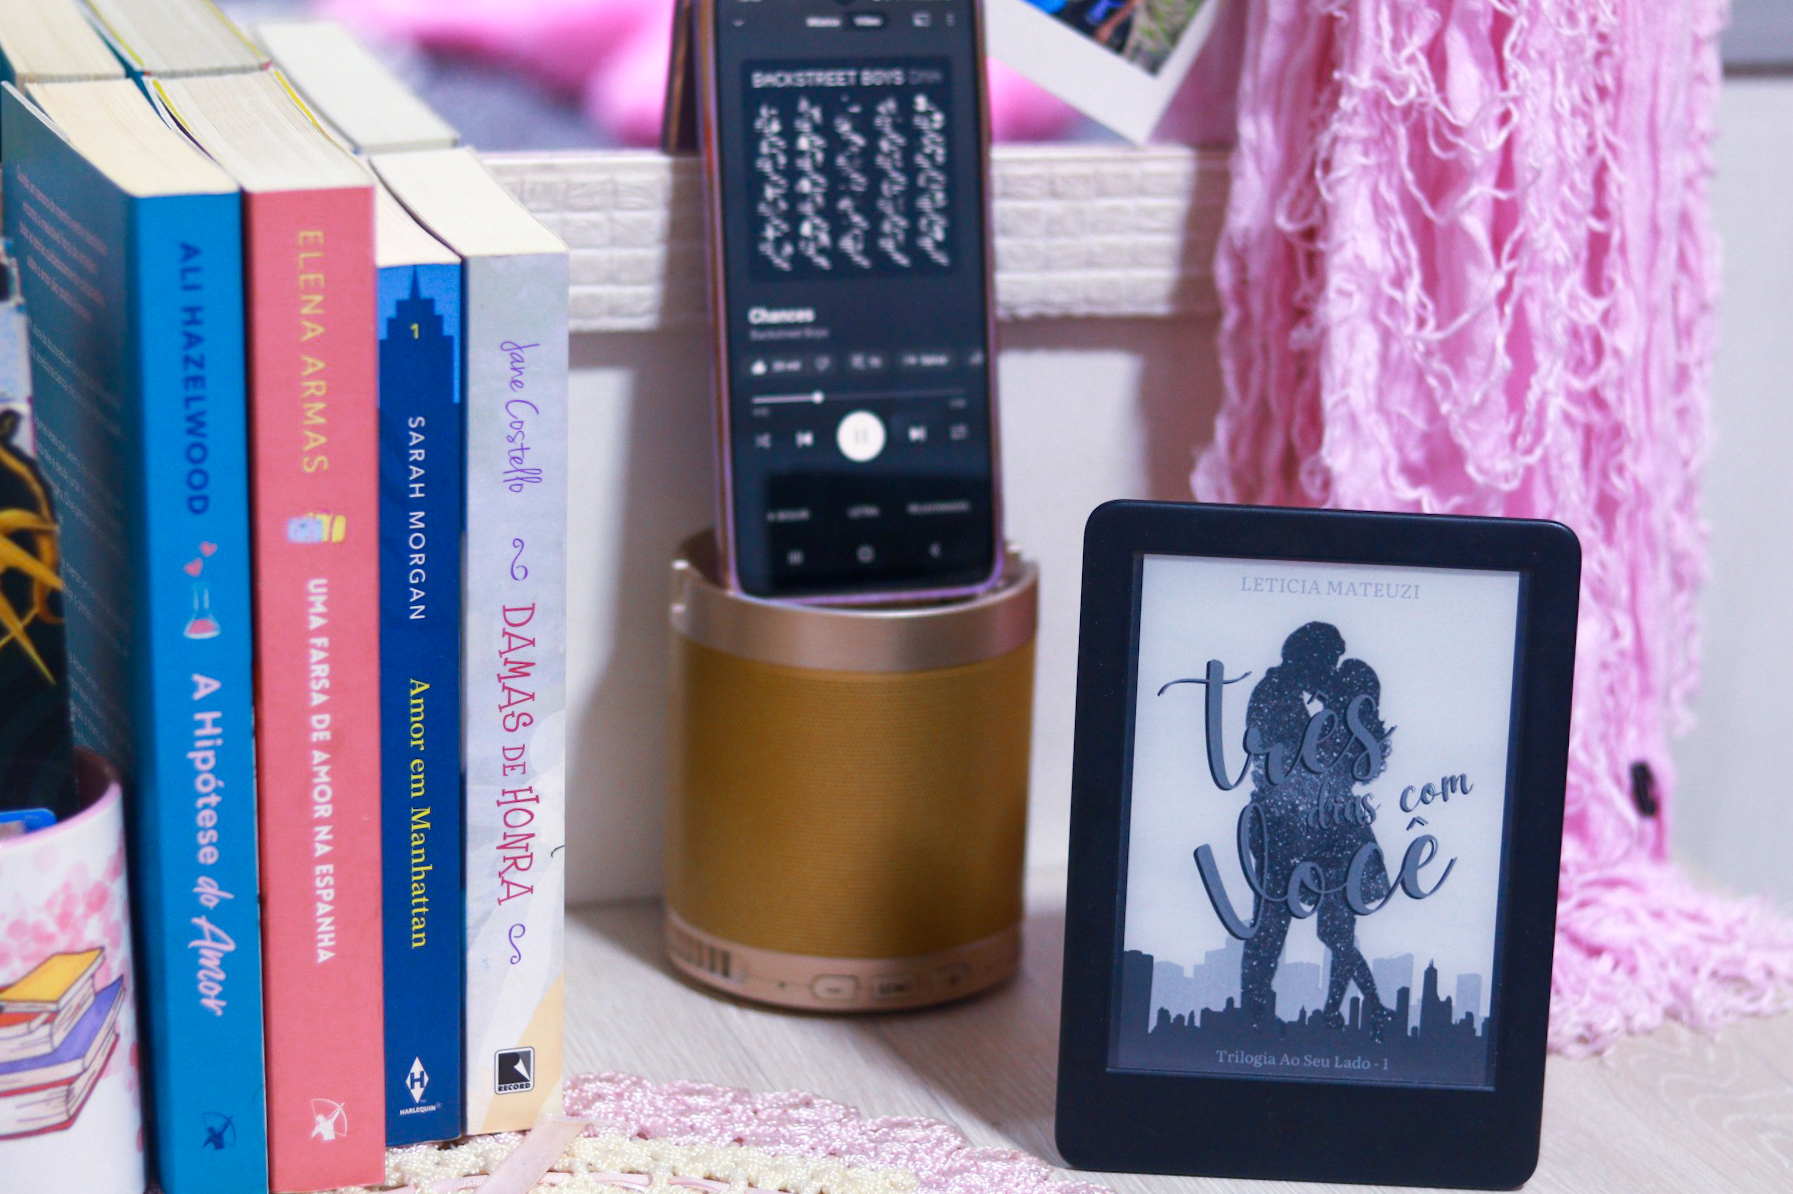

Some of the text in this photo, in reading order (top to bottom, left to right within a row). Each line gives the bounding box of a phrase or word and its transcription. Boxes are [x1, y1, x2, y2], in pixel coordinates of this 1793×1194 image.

[861, 68, 905, 86] BOYS
[179, 242, 210, 516] ALI HAZELWOOD
[298, 229, 329, 474] ELENA ARMAS
[409, 323, 420, 339] 1
[500, 339, 543, 494] Jane Costello
[408, 416, 426, 621] SARAH MORGAN
[1241, 576, 1420, 600] LETICIA MATEUZI
[307, 578, 337, 964] UMA FARSA DE AMOR NA ESPANHA
[410, 678, 433, 949] Amor em Manhattan
[496, 602, 541, 906] DAMAS DE HONRA
[1399, 772, 1474, 813] com
[187, 673, 236, 1016] A Hipótese do Amor
[399, 1105, 437, 1115] HARLEQUIN
[498, 1083, 531, 1092] RECORD
[1216, 1050, 1276, 1067] Trilogia
[1280, 1053, 1300, 1066] Ao
[1303, 1054, 1330, 1067] Seu
[1334, 1055, 1371, 1069] Lado
